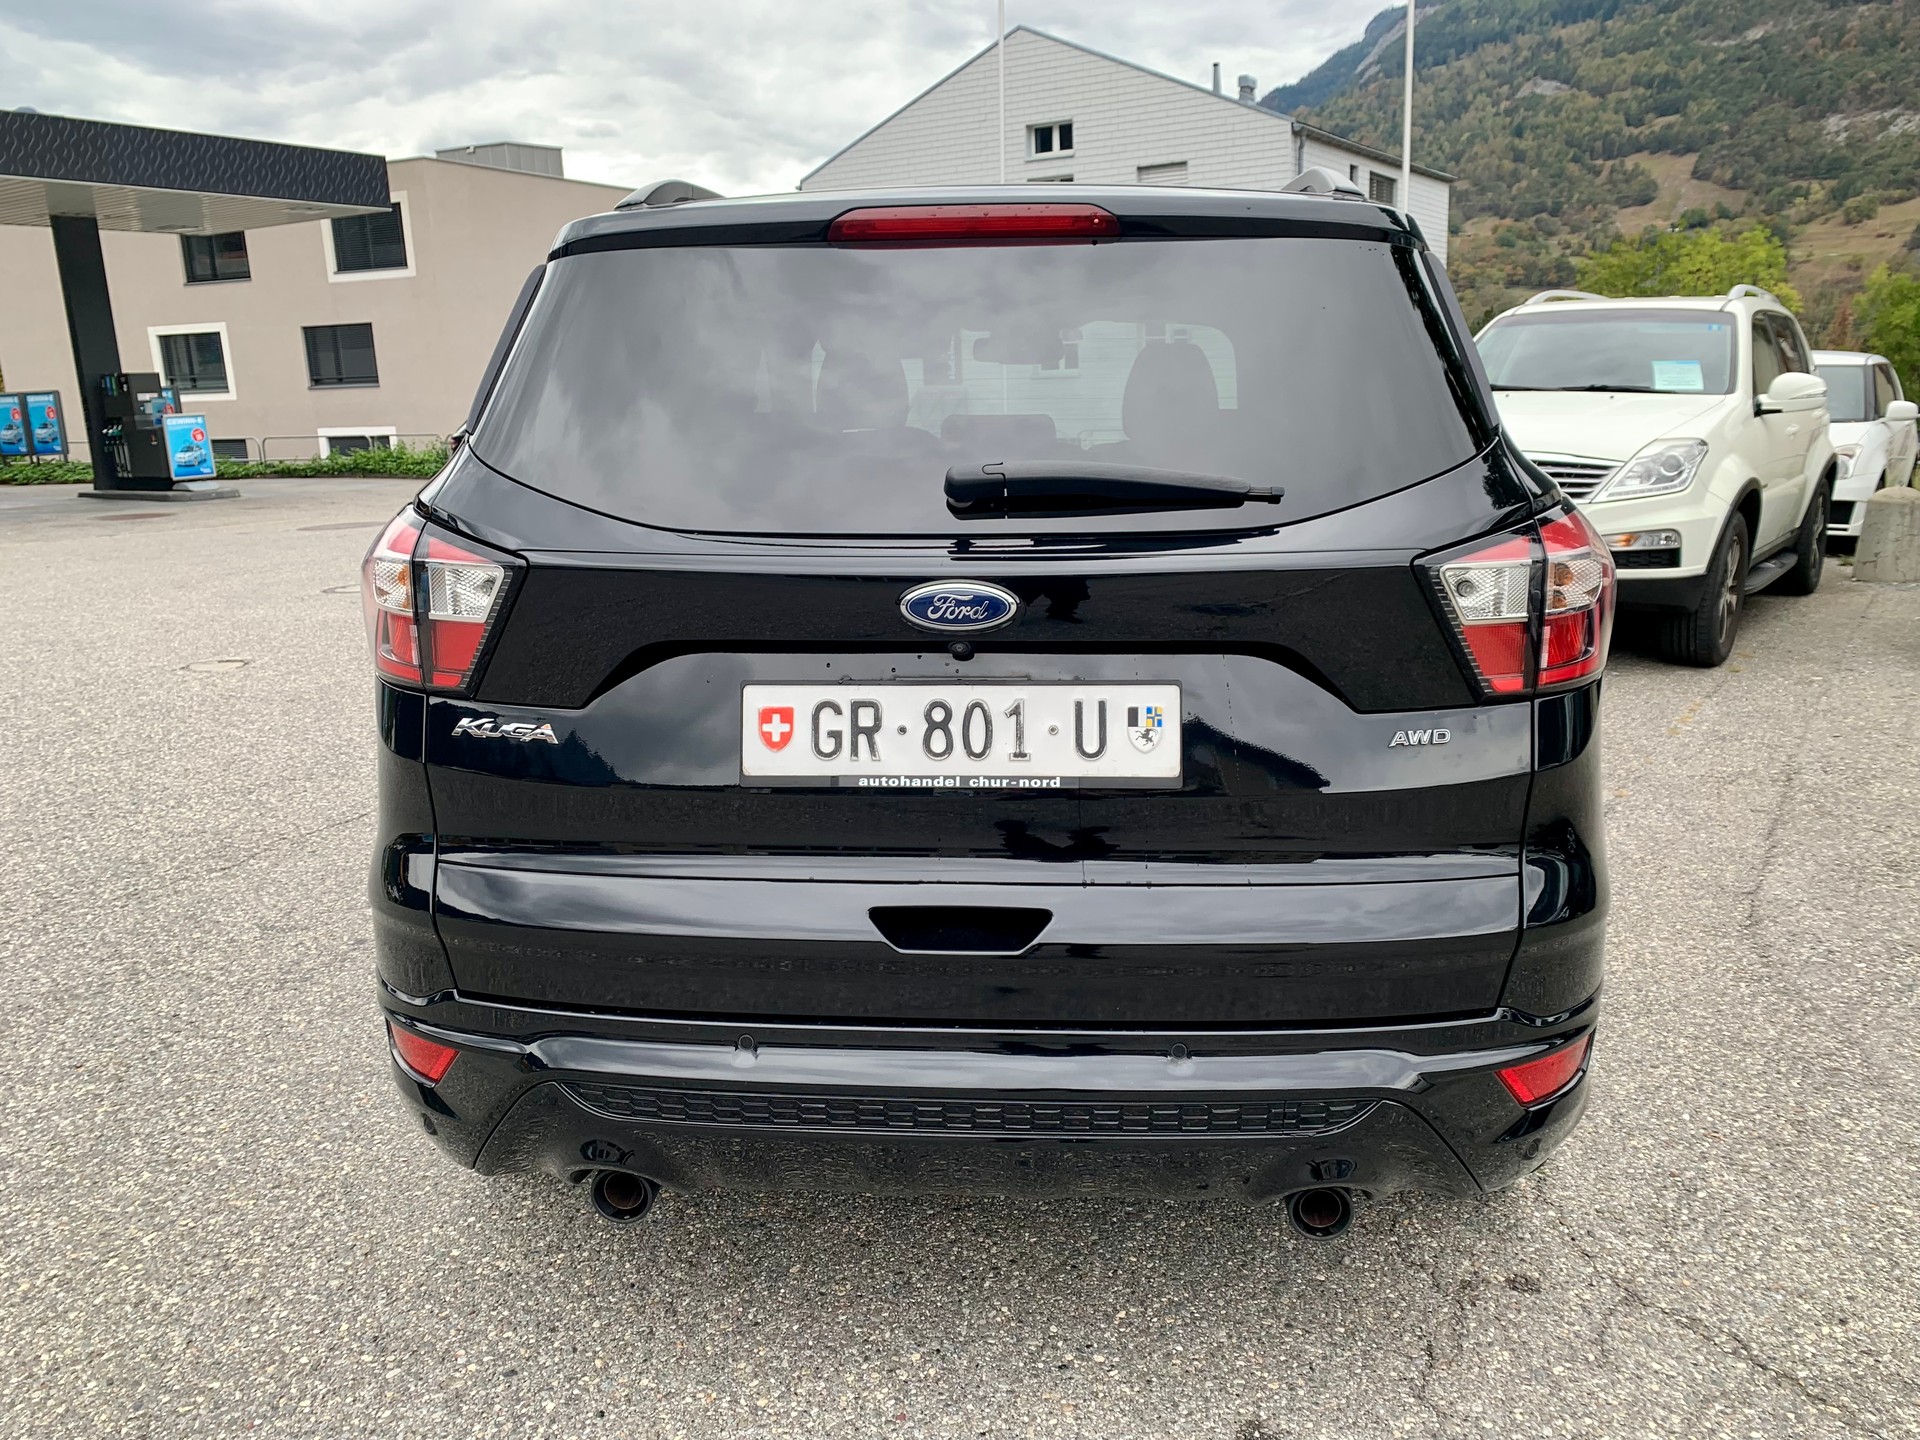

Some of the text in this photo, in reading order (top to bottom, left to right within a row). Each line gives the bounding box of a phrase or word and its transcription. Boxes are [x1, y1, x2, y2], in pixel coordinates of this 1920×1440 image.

[927, 594, 989, 619] Ford
[451, 717, 559, 744] KUGA
[811, 698, 1107, 761] GR 801 U
[1388, 729, 1451, 747] AWD
[859, 776, 1061, 788] autohandel chur-nord
